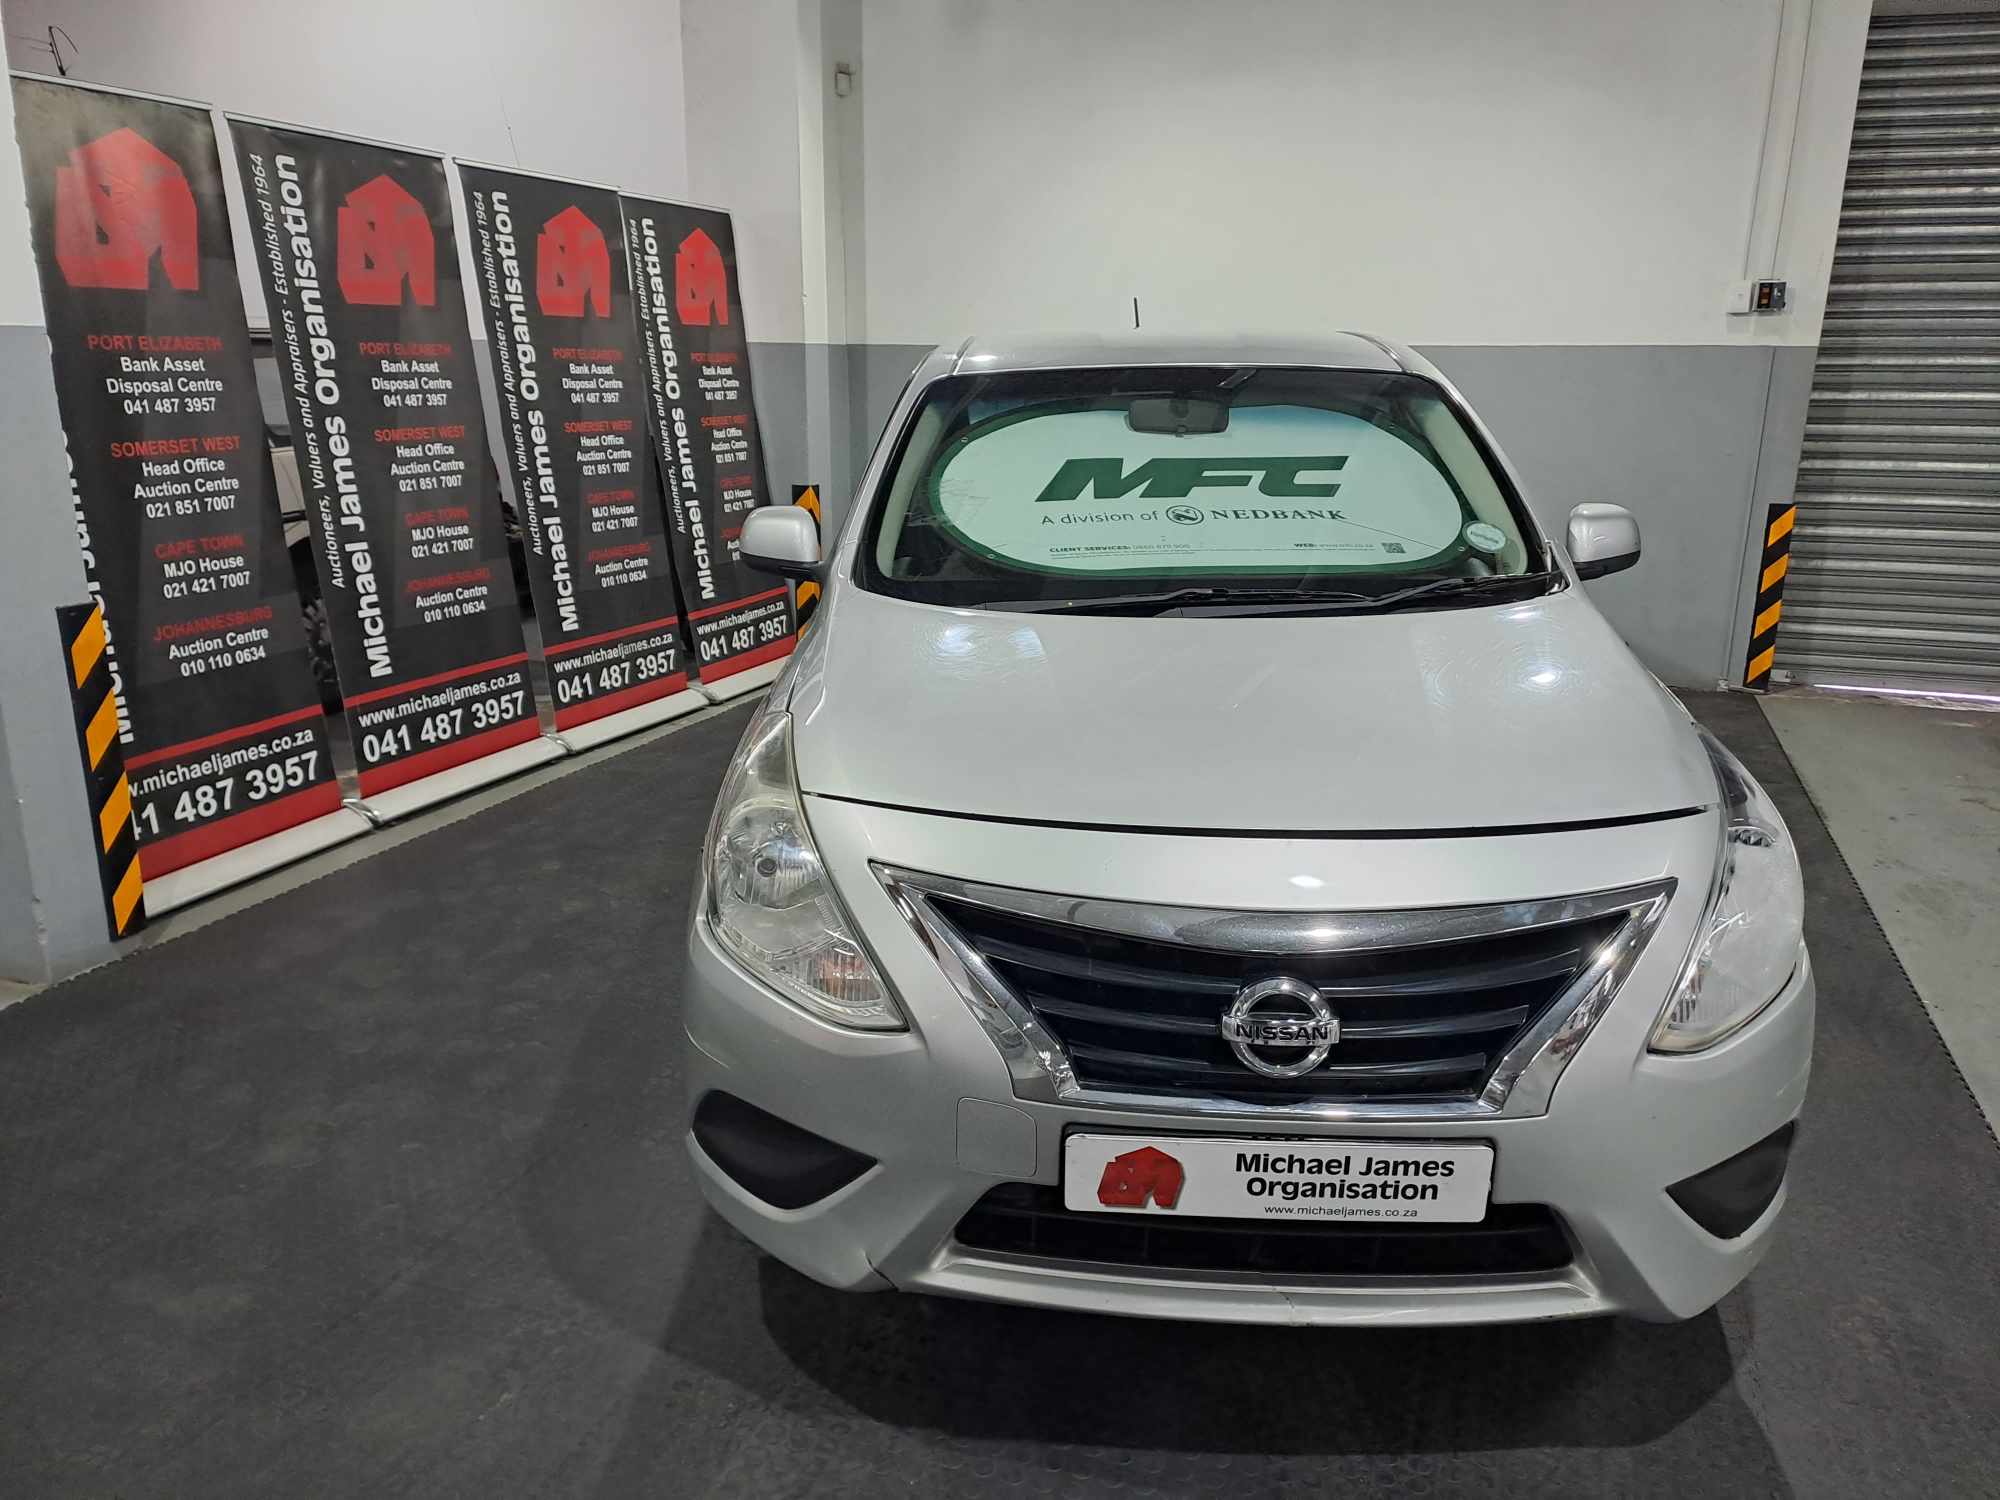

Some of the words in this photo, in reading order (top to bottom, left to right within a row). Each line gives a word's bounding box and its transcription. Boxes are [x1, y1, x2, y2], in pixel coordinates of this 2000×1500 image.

[249, 152, 270, 195] 1964
[257, 199, 289, 296] Established
[275, 154, 340, 406] Organisation
[478, 228, 501, 309] Established
[491, 191, 540, 401] Organisation
[641, 217, 680, 400] Organisation
[88, 335, 133, 350] PORT
[282, 308, 309, 394] Appraisers
[359, 342, 391, 355] PORT
[120, 356, 160, 372] Bank
[163, 356, 205, 372] Asset
[381, 359, 409, 373] Bank
[411, 359, 440, 373] Asset
[495, 319, 516, 392] Appraisers
[569, 363, 590, 374] Bank
[591, 363, 614, 374] Asset
[106, 378, 174, 396] Disposal
[177, 377, 223, 392] Centre
[371, 377, 419, 392] Disposal
[421, 377, 453, 390] Centre
[562, 378, 597, 391] Disposal
[598, 378, 623, 389] Centre
[124, 399, 150, 415] 041
[154, 398, 179, 413] 487
[185, 397, 216, 412] 3957
[295, 396, 314, 428] and
[383, 394, 402, 407] 041
[404, 394, 423, 407] 487
[426, 393, 447, 406] 3957
[505, 393, 520, 420] and
[653, 393, 665, 417] and
[111, 438, 198, 458] SOMERSET
[202, 436, 240, 451] WEST
[396, 445, 423, 458] Head
[424, 443, 455, 456] Office
[512, 423, 529, 472] Valuers
[580, 435, 600, 447] Head
[601, 434, 624, 445] Office
[671, 407, 697, 493] James
[142, 460, 180, 476] Head
[183, 457, 225, 473] Office
[305, 431, 326, 490] Valuers
[527, 409, 558, 509] James
[576, 450, 605, 462] Auction
[606, 448, 632, 460] Centre
[325, 415, 366, 532] James
[390, 462, 431, 476] Auction
[433, 459, 465, 472] Centre
[1034, 455, 1349, 502] MFC
[134, 481, 191, 499] Auction
[195, 477, 239, 492] Centre
[399, 478, 418, 492] 021
[419, 477, 438, 490] 851
[440, 474, 462, 487] 7007
[146, 502, 171, 518] 021
[175, 499, 200, 515] 851
[204, 495, 236, 511] 7007
[522, 476, 544, 556] Auctioneers,
[609, 505, 635, 516] House
[1041, 515, 1055, 525] A
[1060, 511, 1134, 524] division
[1140, 510, 1159, 521] of
[1210, 509, 1348, 520] NEDBANK
[318, 495, 346, 589] Auctioneers,
[411, 526, 435, 541] MJO
[436, 524, 469, 538] House
[154, 540, 196, 559] CAPE
[411, 544, 429, 558] 021
[431, 541, 449, 554] 421
[451, 538, 474, 552] 7007
[684, 499, 716, 600] Michael
[163, 560, 196, 578] MJO
[199, 555, 244, 573] House
[542, 516, 580, 632] Michael
[595, 561, 623, 575] Auction
[624, 558, 648, 569] Centre
[163, 582, 188, 599] 021
[192, 577, 216, 593] 421
[220, 571, 250, 589] 7007
[415, 591, 454, 608] Auction
[455, 585, 488, 600] Centre
[344, 541, 393, 678] Michael
[424, 608, 442, 623] 010
[443, 604, 461, 619] 110
[169, 638, 223, 660] Auction
[226, 627, 268, 646] Centre
[700, 634, 728, 661] 041
[731, 625, 754, 650] 487
[758, 614, 787, 642] 3957
[181, 659, 205, 677] 010
[208, 653, 232, 670] 110
[235, 645, 266, 664] 0634
[553, 633, 673, 673] www.michaeljames.co.za
[557, 672, 593, 703] 041
[599, 662, 631, 690] 487
[636, 649, 675, 679] 3957
[358, 671, 521, 728] www.michaeljames.co.za
[362, 723, 412, 763] 041
[420, 708, 463, 744] 487
[471, 690, 524, 729] 3957
[173, 777, 234, 822] 487
[245, 750, 318, 801] 3957
[1236, 1023, 1328, 1040] NISSAN
[1235, 1153, 1351, 1175] Michael
[1358, 1156, 1455, 1177] James
[1246, 1176, 1439, 1201] Organisation
